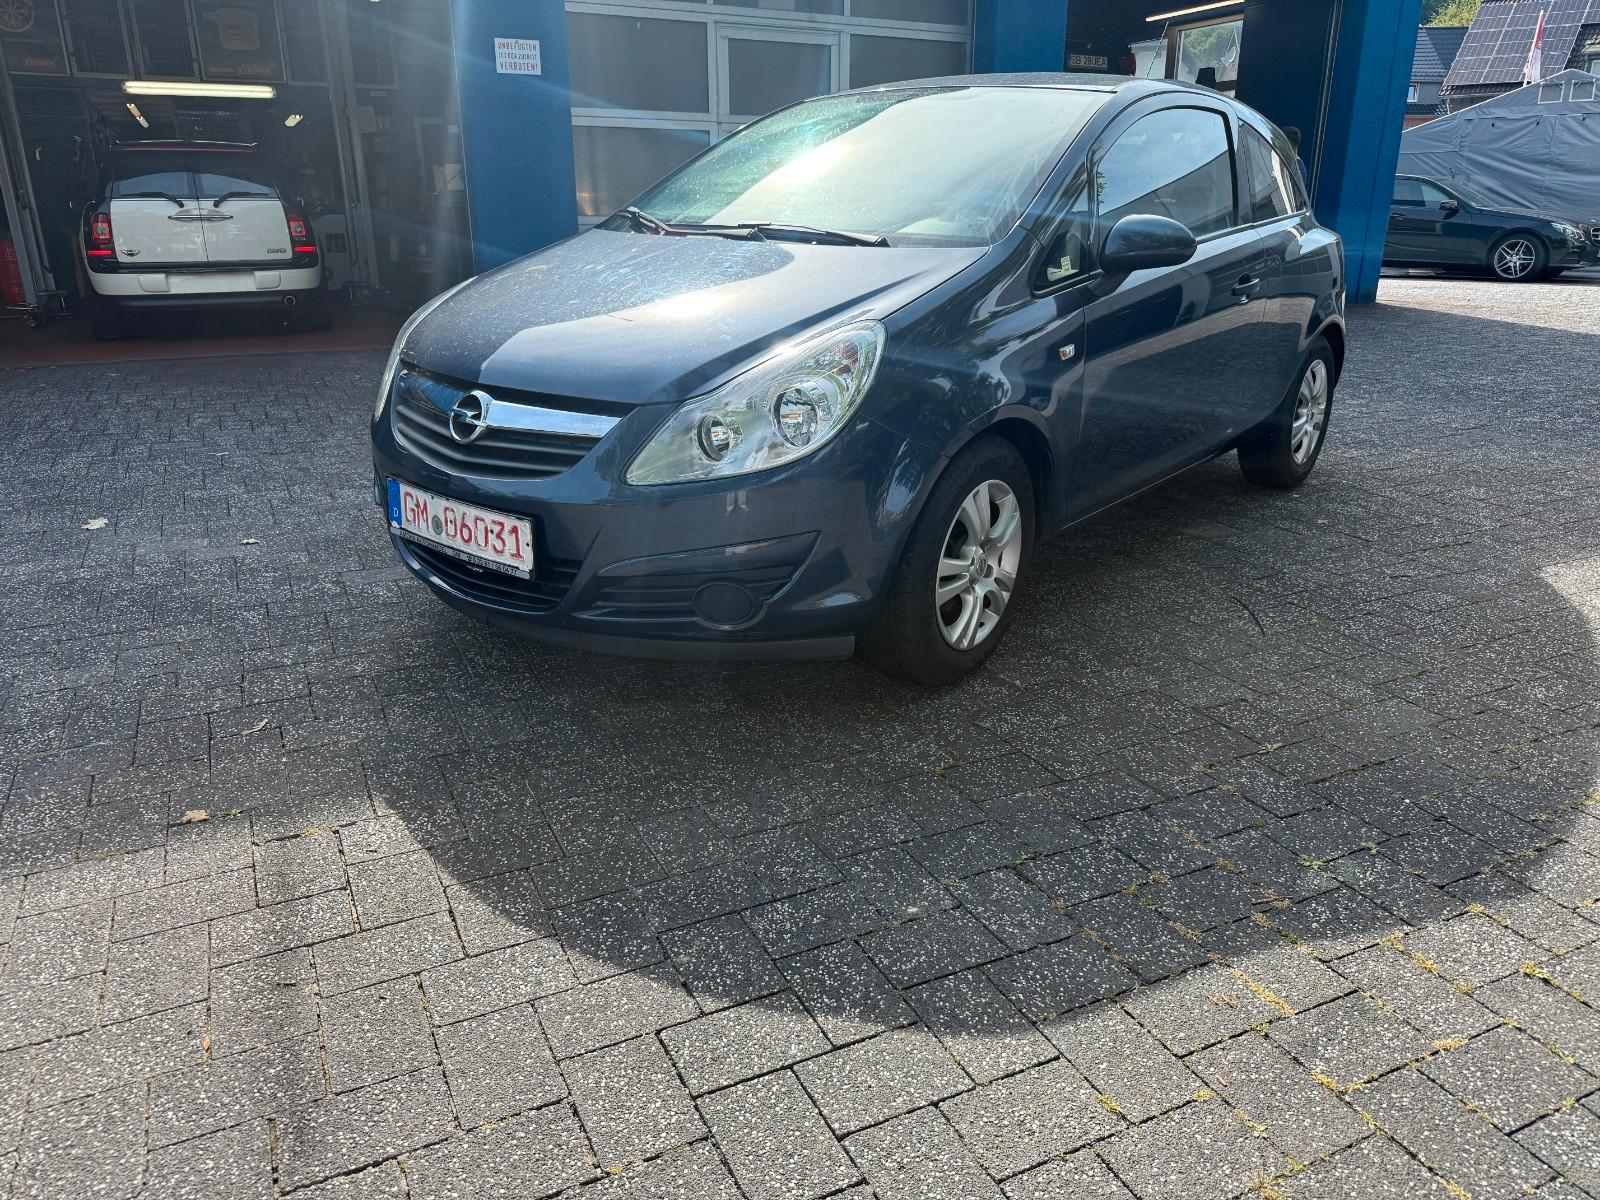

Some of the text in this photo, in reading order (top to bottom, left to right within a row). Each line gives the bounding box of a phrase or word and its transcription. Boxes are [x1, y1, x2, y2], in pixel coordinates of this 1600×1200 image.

[498, 41, 537, 51] UNBEFUGTEN
[403, 491, 430, 532] GM
[443, 505, 525, 560] 06031
